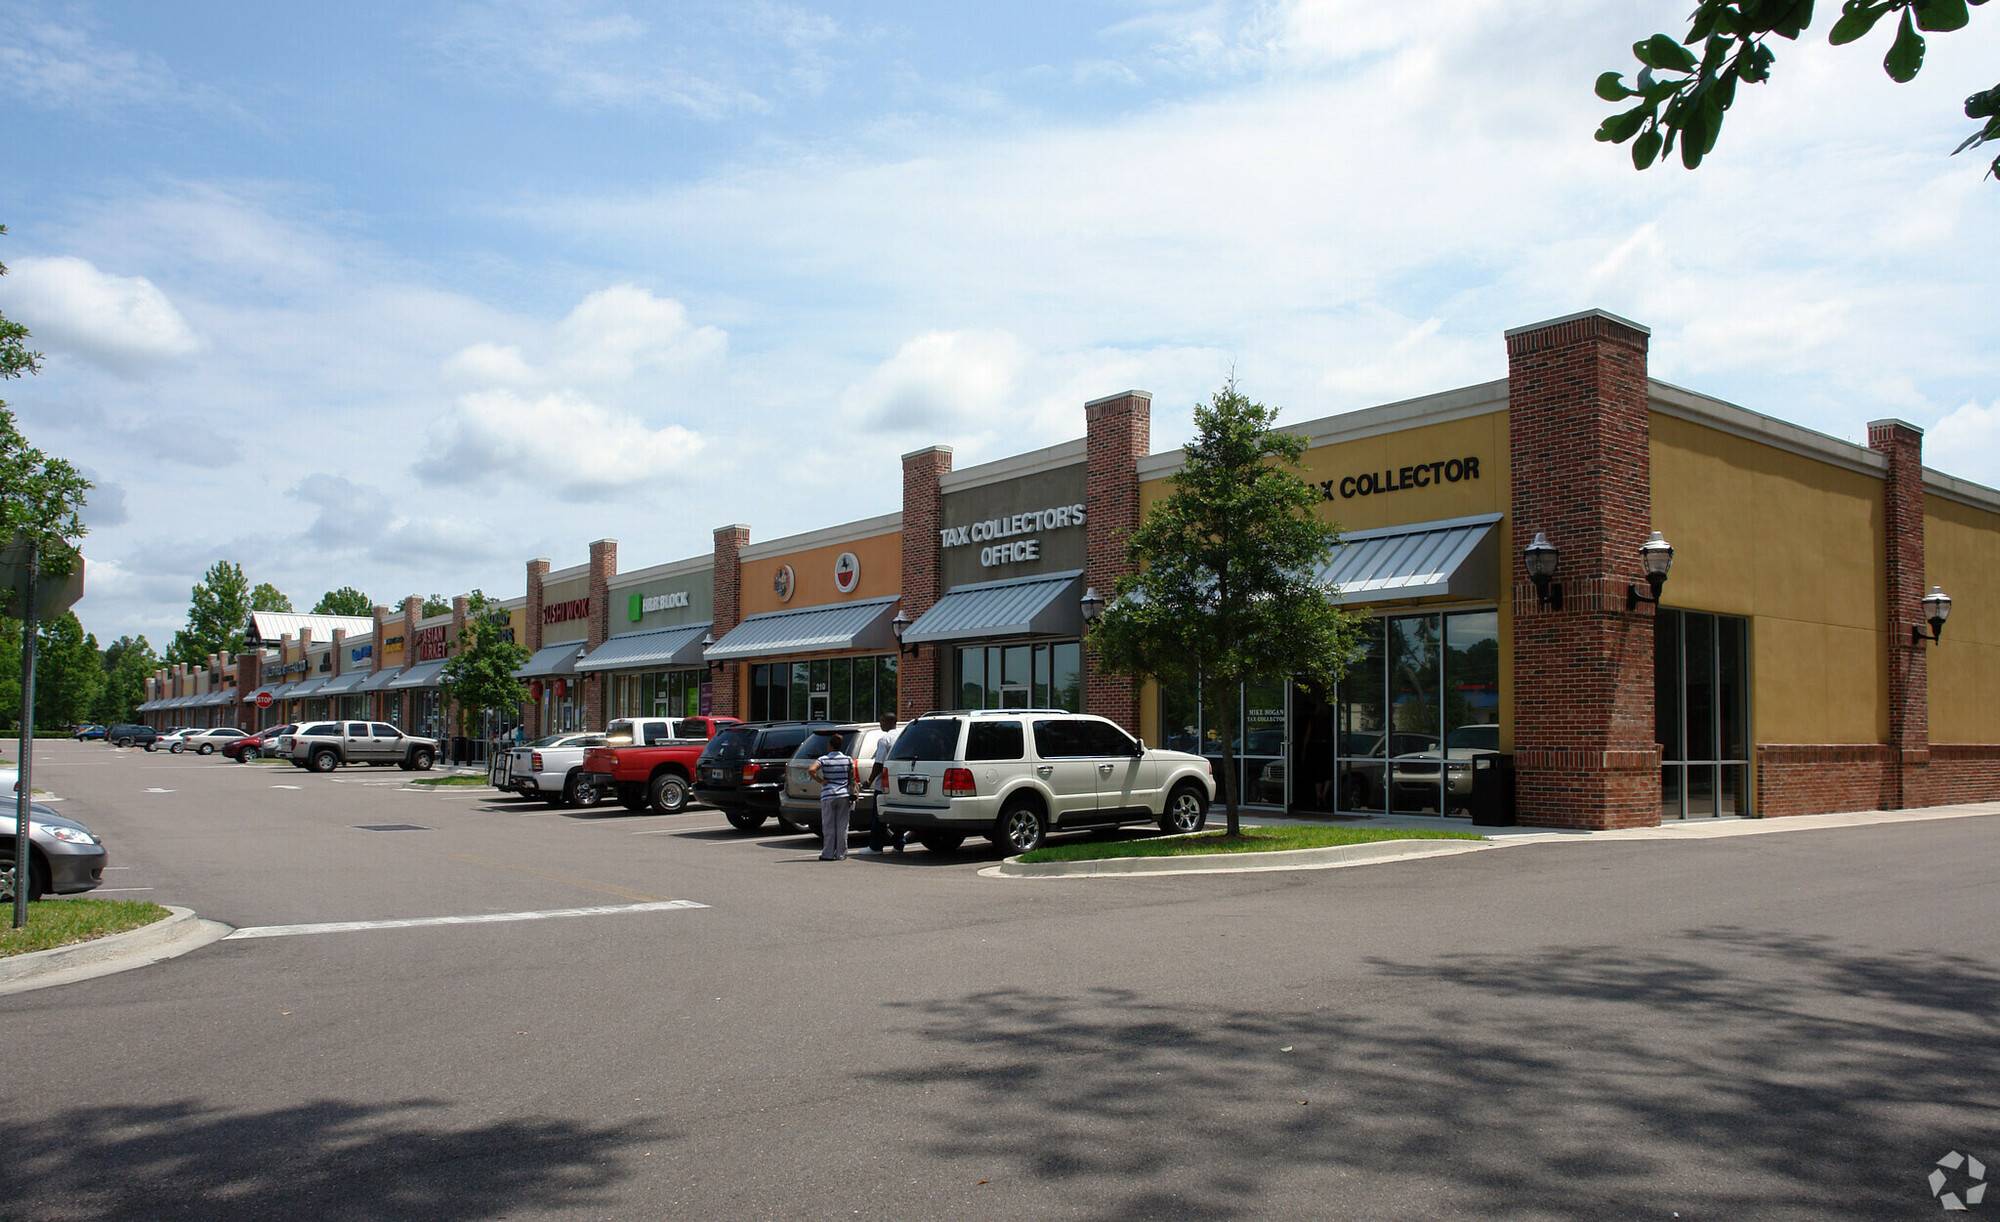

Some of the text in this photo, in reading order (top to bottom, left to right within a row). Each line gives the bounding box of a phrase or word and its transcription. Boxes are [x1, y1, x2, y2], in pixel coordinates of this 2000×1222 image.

[1339, 456, 1480, 499] COLLECTOR
[940, 503, 1087, 548] TAX COLLECTOR'S
[981, 539, 1041, 567] OFFICE
[542, 597, 591, 625] SUSHI WOK
[660, 591, 689, 610] BLOCK
[421, 625, 446, 643] ASIAN
